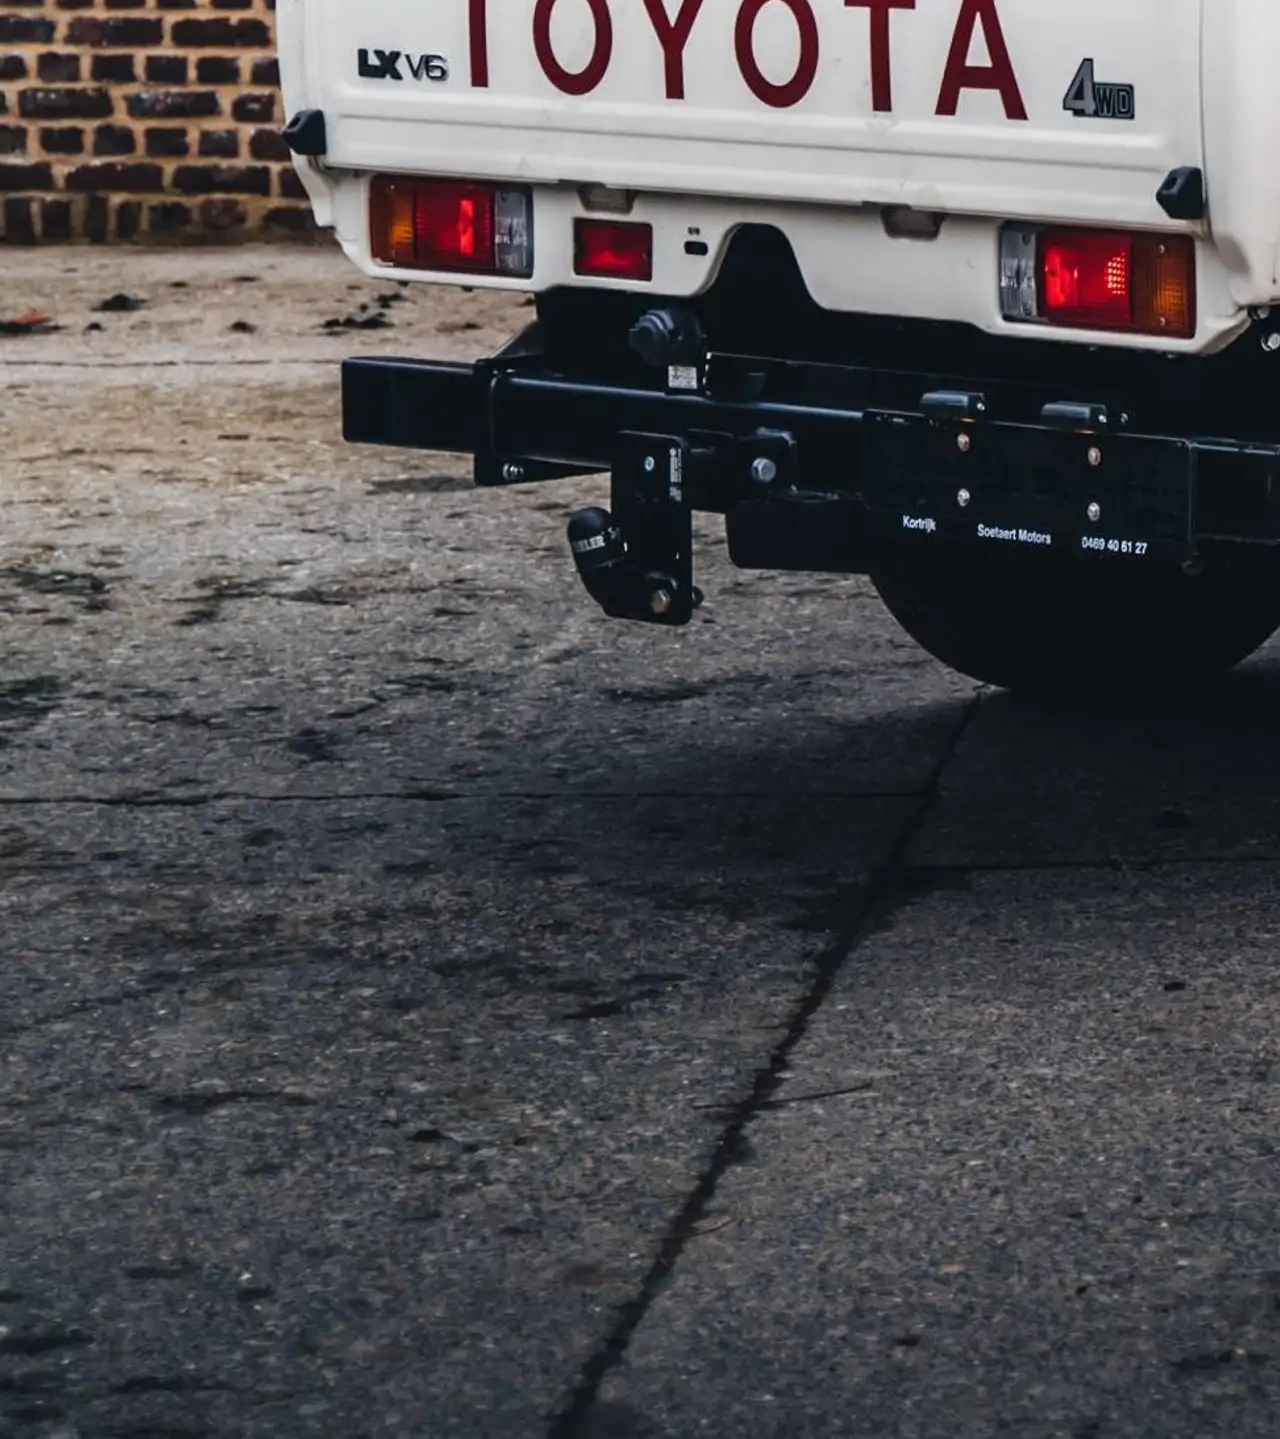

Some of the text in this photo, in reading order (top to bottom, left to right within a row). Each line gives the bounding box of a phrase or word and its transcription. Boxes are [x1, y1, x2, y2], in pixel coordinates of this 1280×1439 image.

[358, 48, 448, 81] LX V6
[1062, 57, 1135, 120] 4WD
[902, 515, 936, 534] Kortrijk
[977, 523, 1052, 545] Soetaert Motors
[1107, 538, 1120, 552] 40
[1134, 541, 1148, 555] 27
